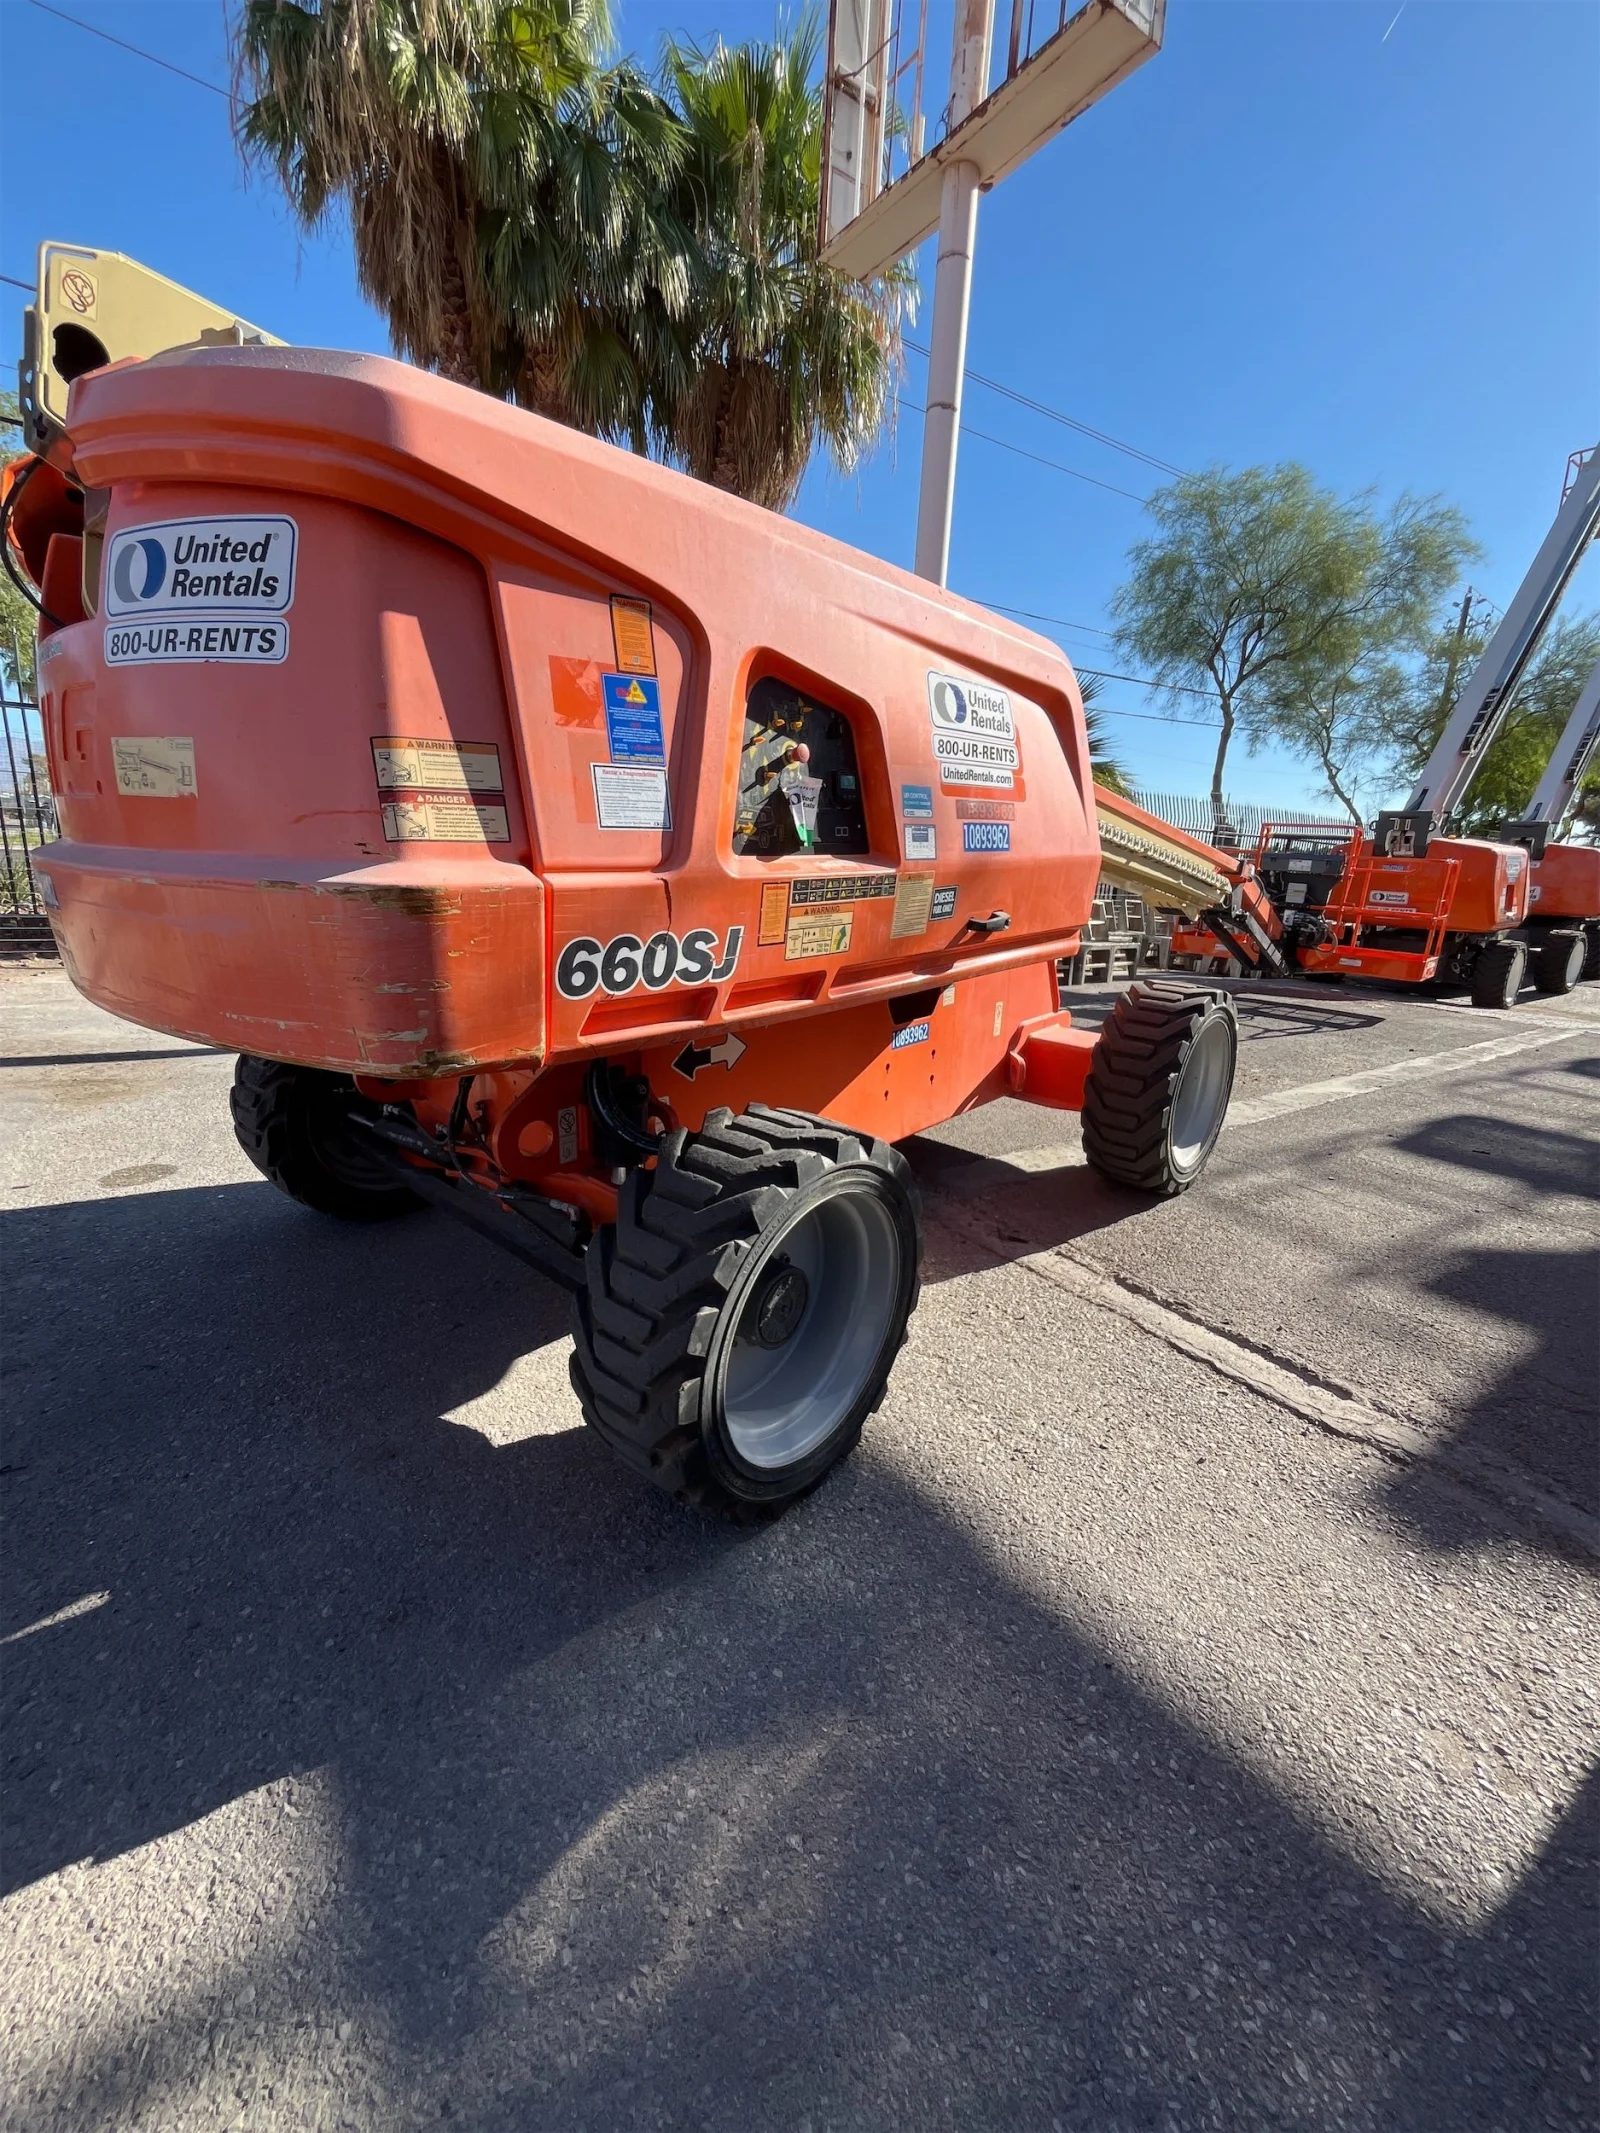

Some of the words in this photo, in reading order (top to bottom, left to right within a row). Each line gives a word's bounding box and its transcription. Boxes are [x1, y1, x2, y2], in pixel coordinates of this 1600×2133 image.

[173, 533, 272, 565] United
[170, 567, 279, 598] Rentals
[110, 627, 277, 657] 800-UR-RENTS
[968, 689, 1005, 714] United
[970, 709, 1011, 734] Rentals
[416, 740, 463, 751] WARNING
[937, 738, 1015, 763] 800-UR-RENTS
[943, 767, 1012, 785] UnitedRentals.com
[425, 794, 467, 804] DANGER
[963, 824, 1009, 849] 10893962
[934, 890, 955, 904] DIESEL
[810, 905, 840, 915] WARNING
[556, 926, 745, 1000] 660SJ
[892, 1023, 929, 1049] 10893962
